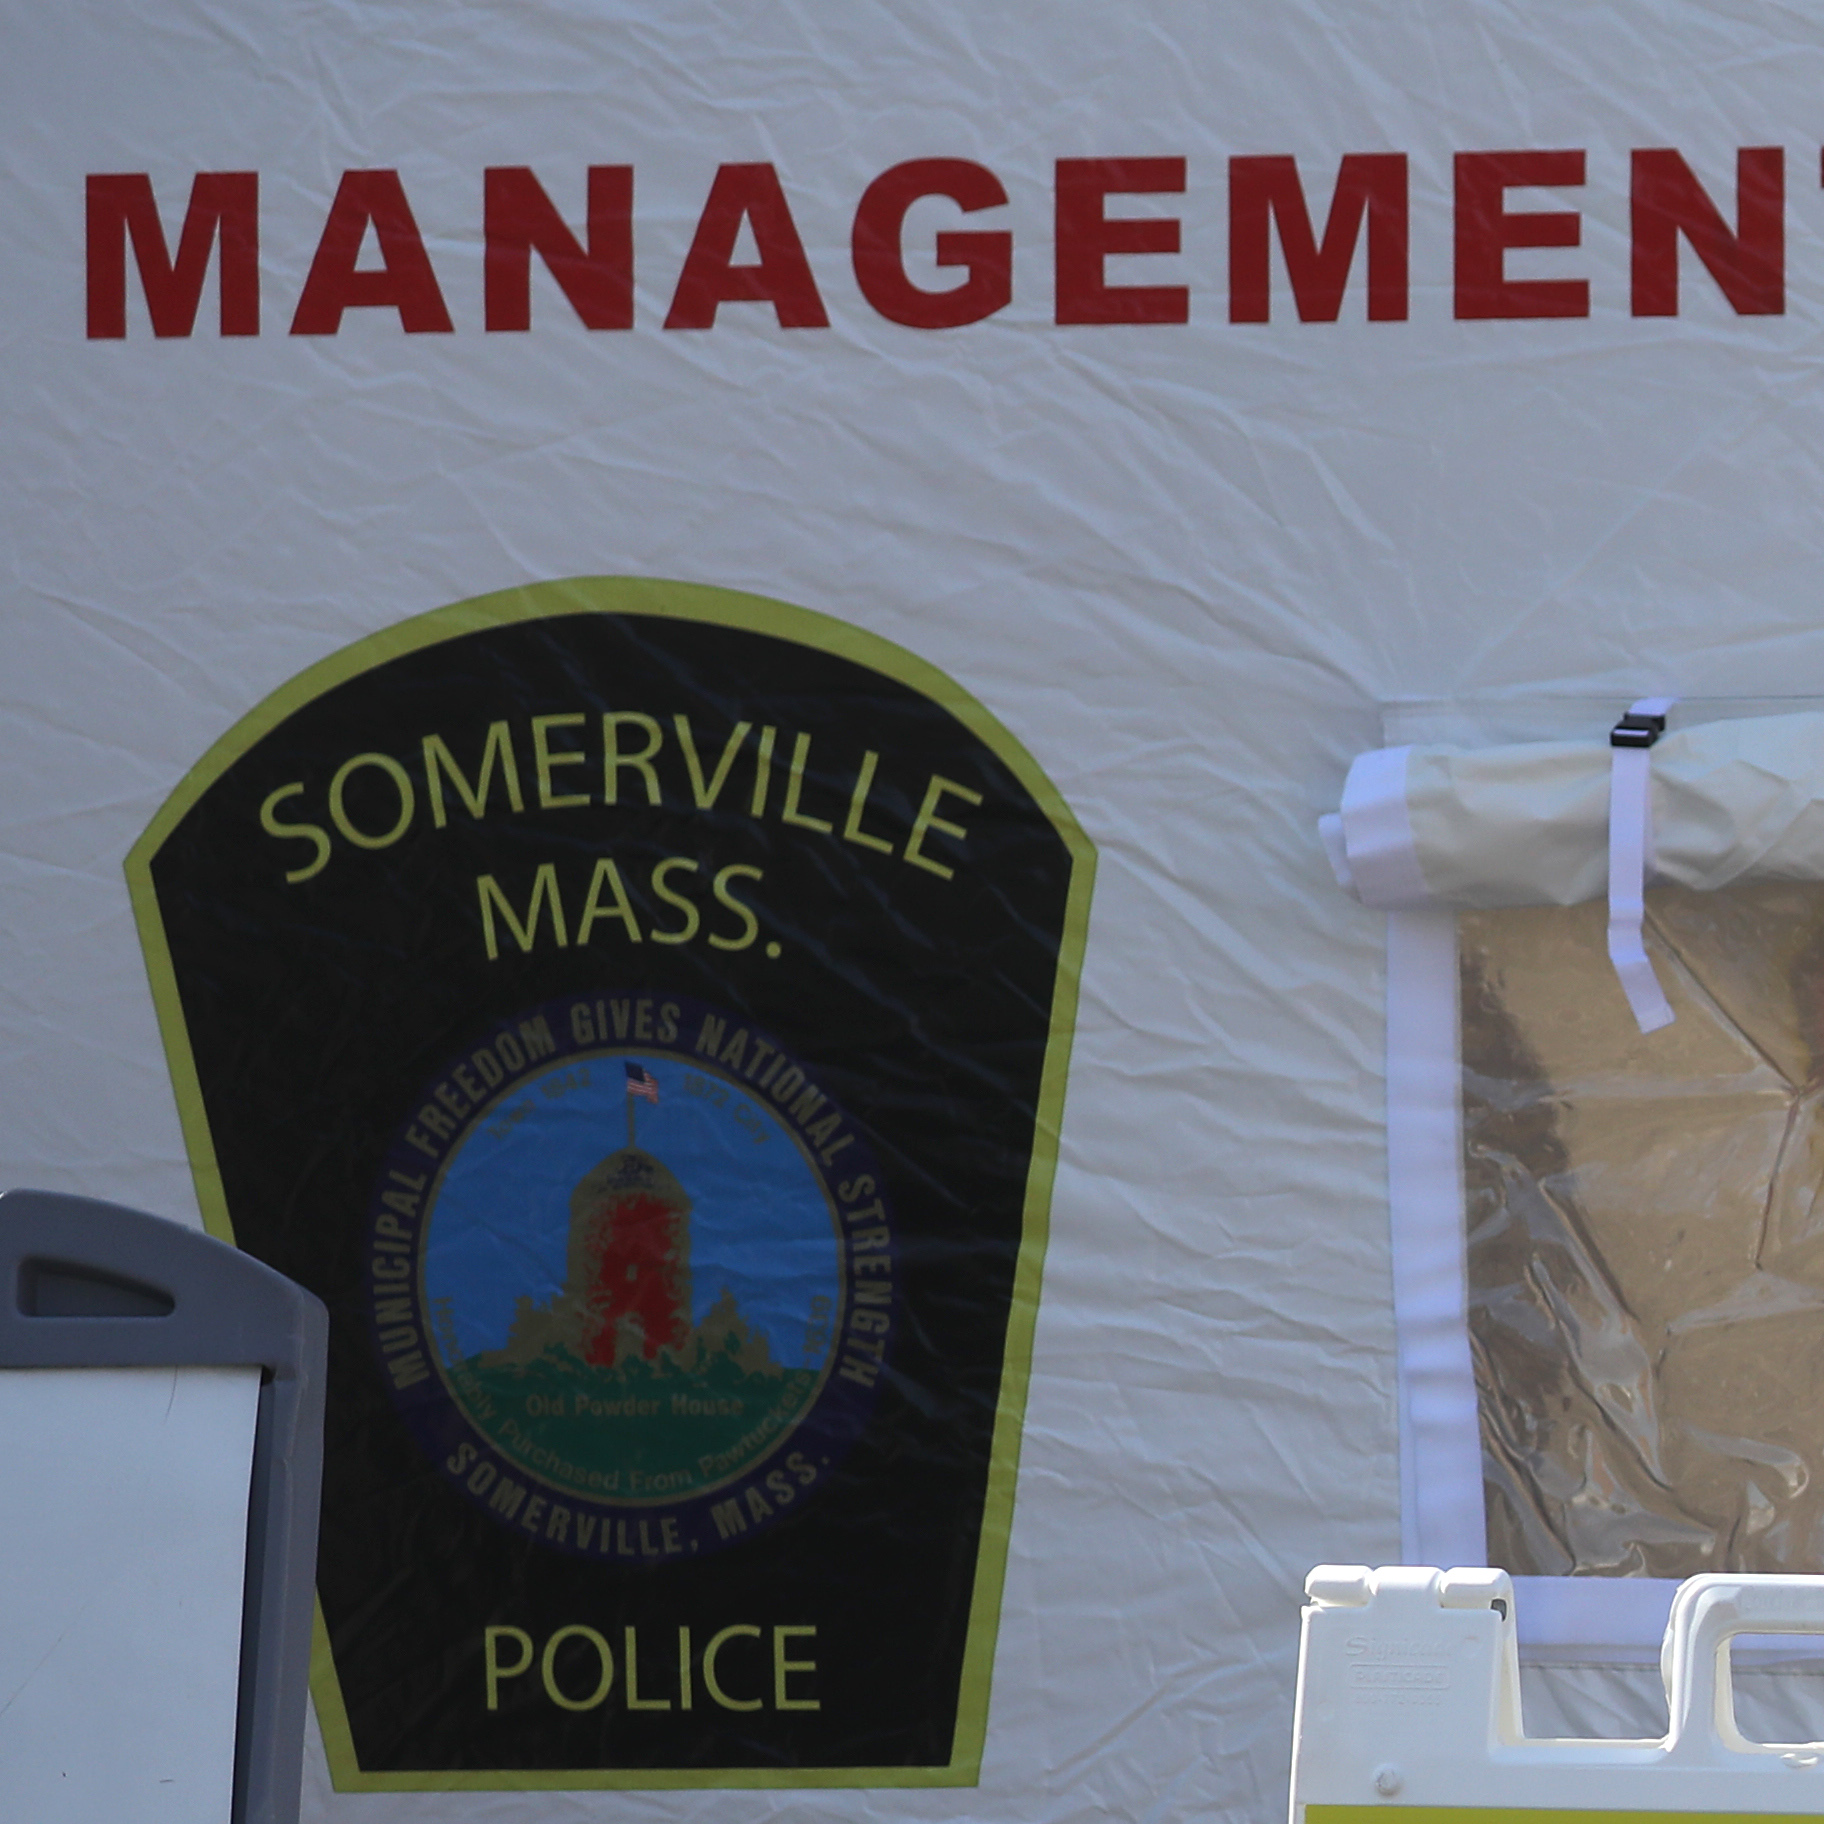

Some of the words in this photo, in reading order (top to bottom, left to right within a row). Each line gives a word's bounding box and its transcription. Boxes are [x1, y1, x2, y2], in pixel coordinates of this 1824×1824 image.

[259, 711, 984, 885] SOMERVILLE
[475, 857, 783, 960] MASS.
[372, 1170, 429, 1388] MUNICIPAL
[405, 1014, 557, 1158] FREEDOM
[571, 998, 681, 1044] GIVES
[696, 1013, 855, 1165] NATIONAL
[838, 1173, 891, 1388] STRENGTH
[526, 1393, 564, 1417] Old
[576, 1393, 660, 1416] Powder
[672, 1393, 745, 1417] House
[498, 1417, 619, 1491] Purchased
[630, 1468, 693, 1492] From
[712, 1446, 830, 1541] MASS.
[485, 1624, 821, 1711] POLICE
